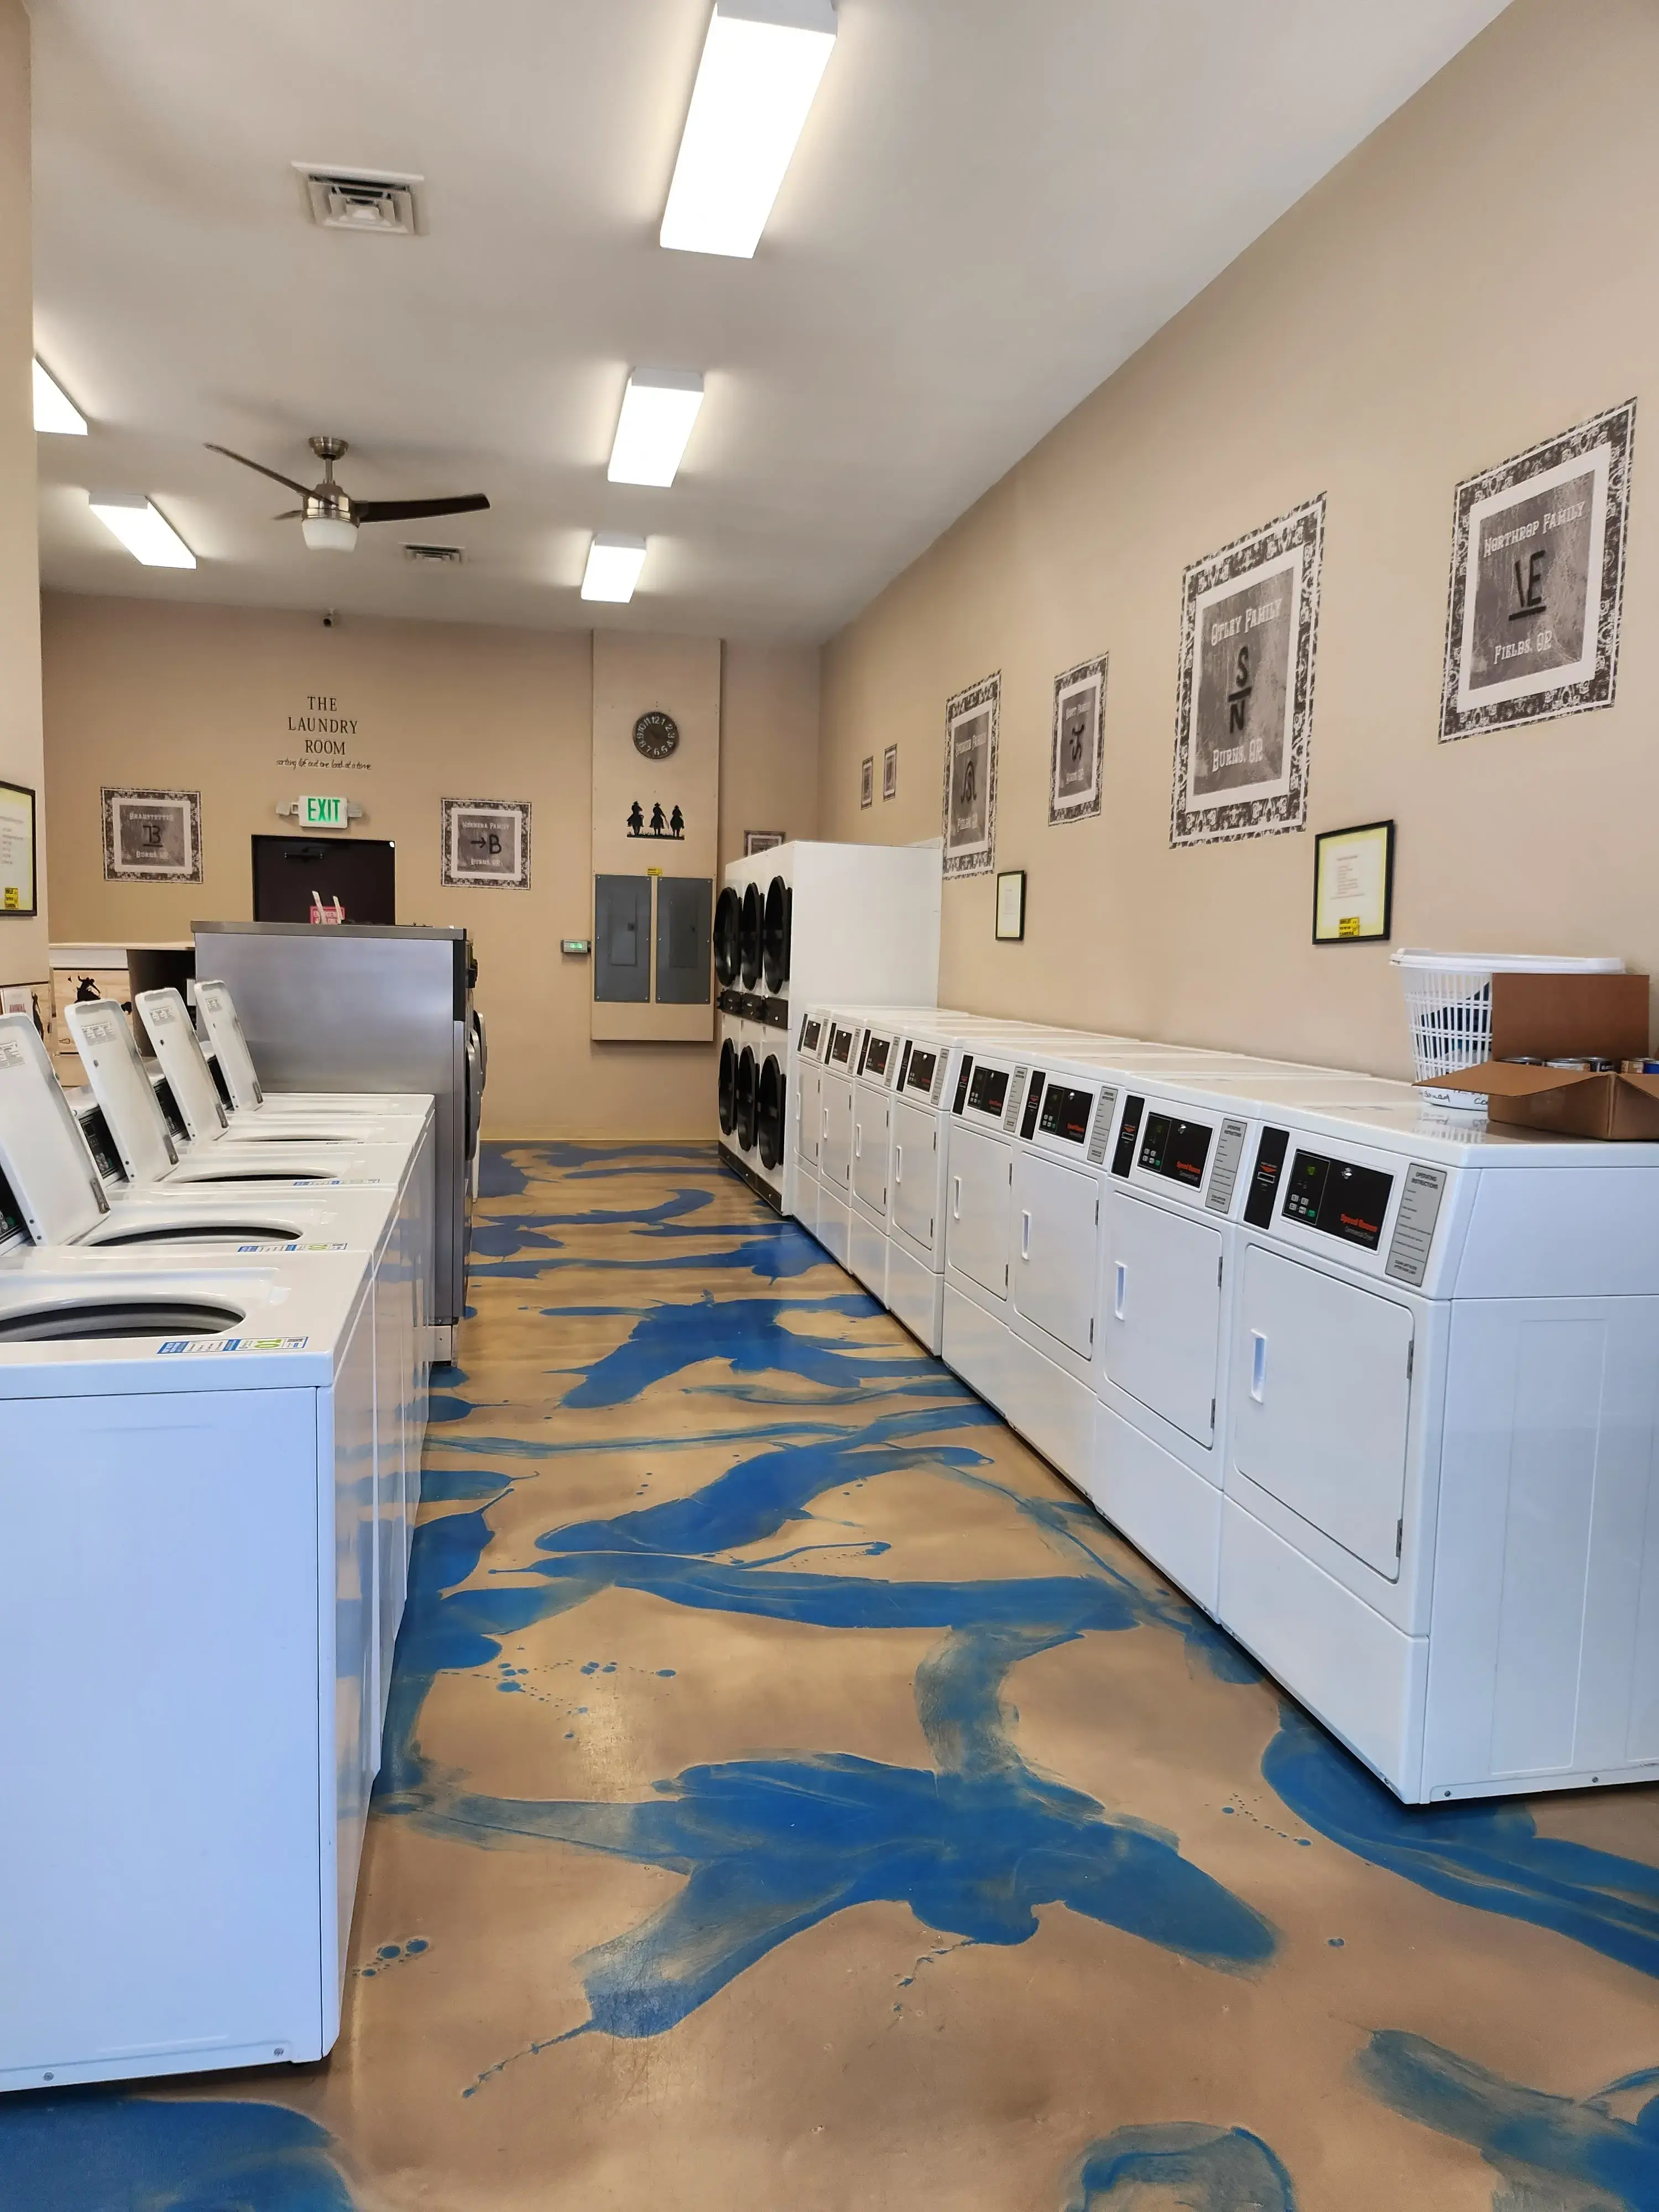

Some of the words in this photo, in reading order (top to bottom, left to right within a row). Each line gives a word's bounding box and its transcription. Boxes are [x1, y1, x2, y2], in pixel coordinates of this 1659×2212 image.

[1542, 500, 1585, 534] FAMILY
[1244, 598, 1284, 634] FAMILY
[307, 696, 337, 712] THE
[288, 717, 358, 734] LAUNDRY
[305, 739, 346, 755] ROOM
[654, 747, 660, 755] 6
[276, 757, 297, 770] sorting
[307, 798, 341, 823] EXIT
